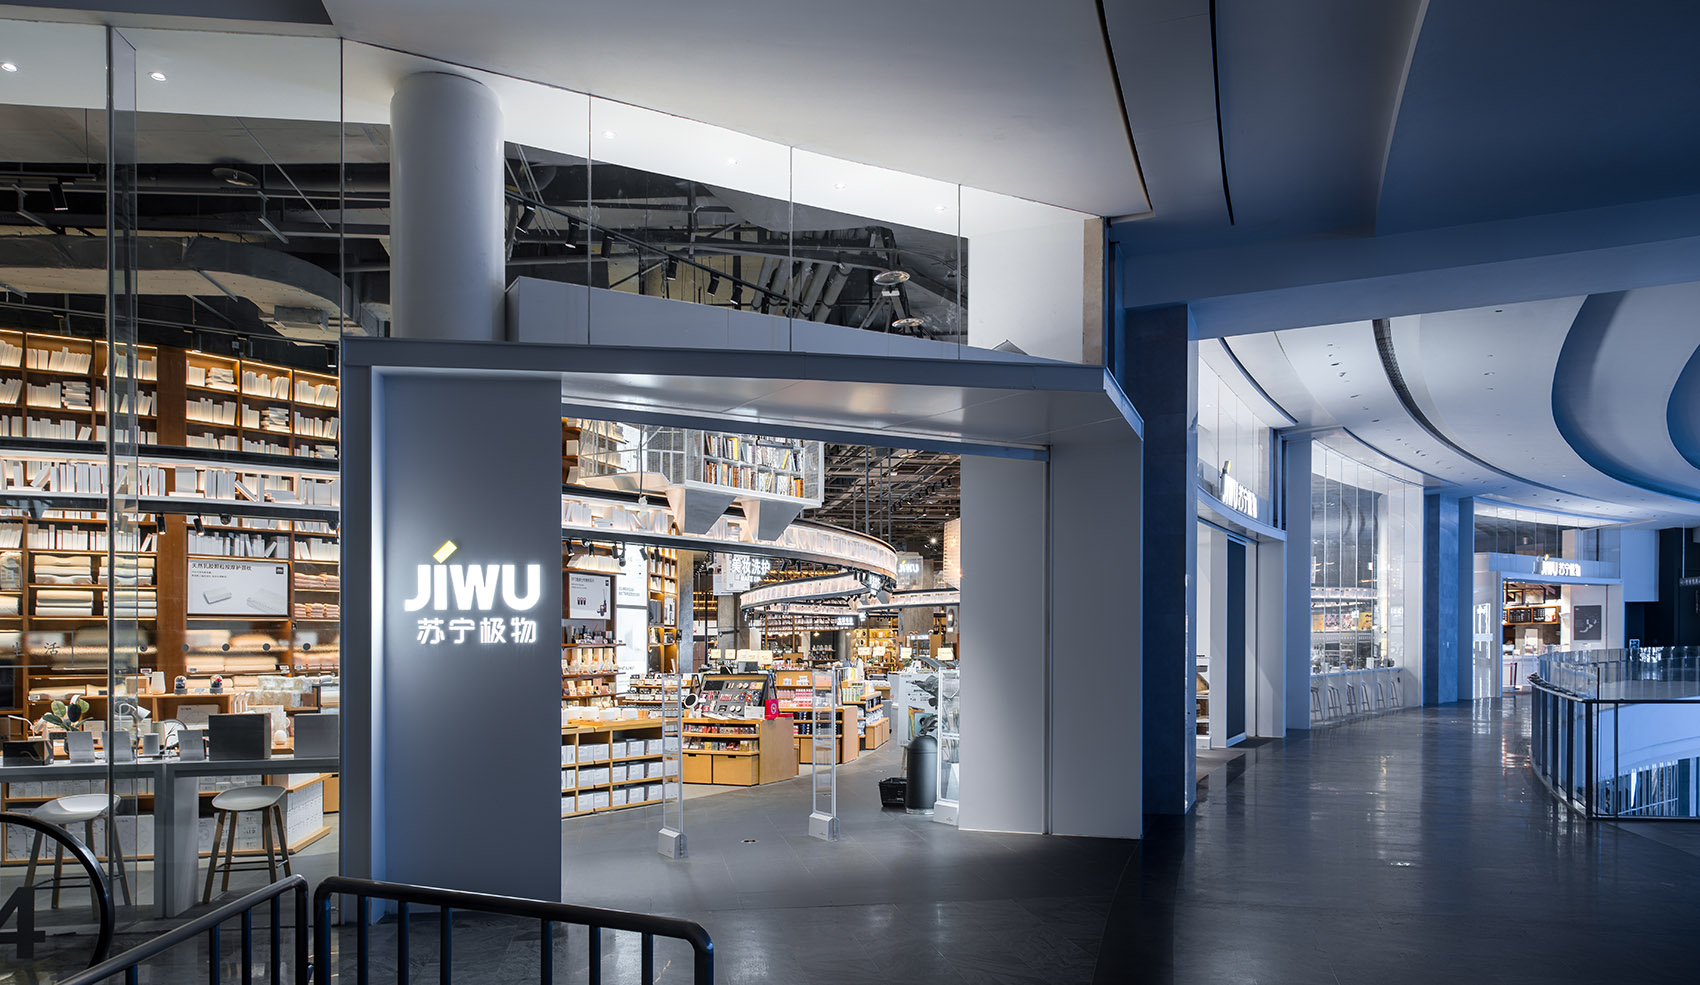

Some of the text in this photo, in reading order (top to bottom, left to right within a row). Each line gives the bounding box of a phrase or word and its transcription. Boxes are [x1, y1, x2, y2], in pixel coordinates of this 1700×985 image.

[404, 540, 541, 612] JIWU
[417, 617, 537, 644] 苏宁极物
